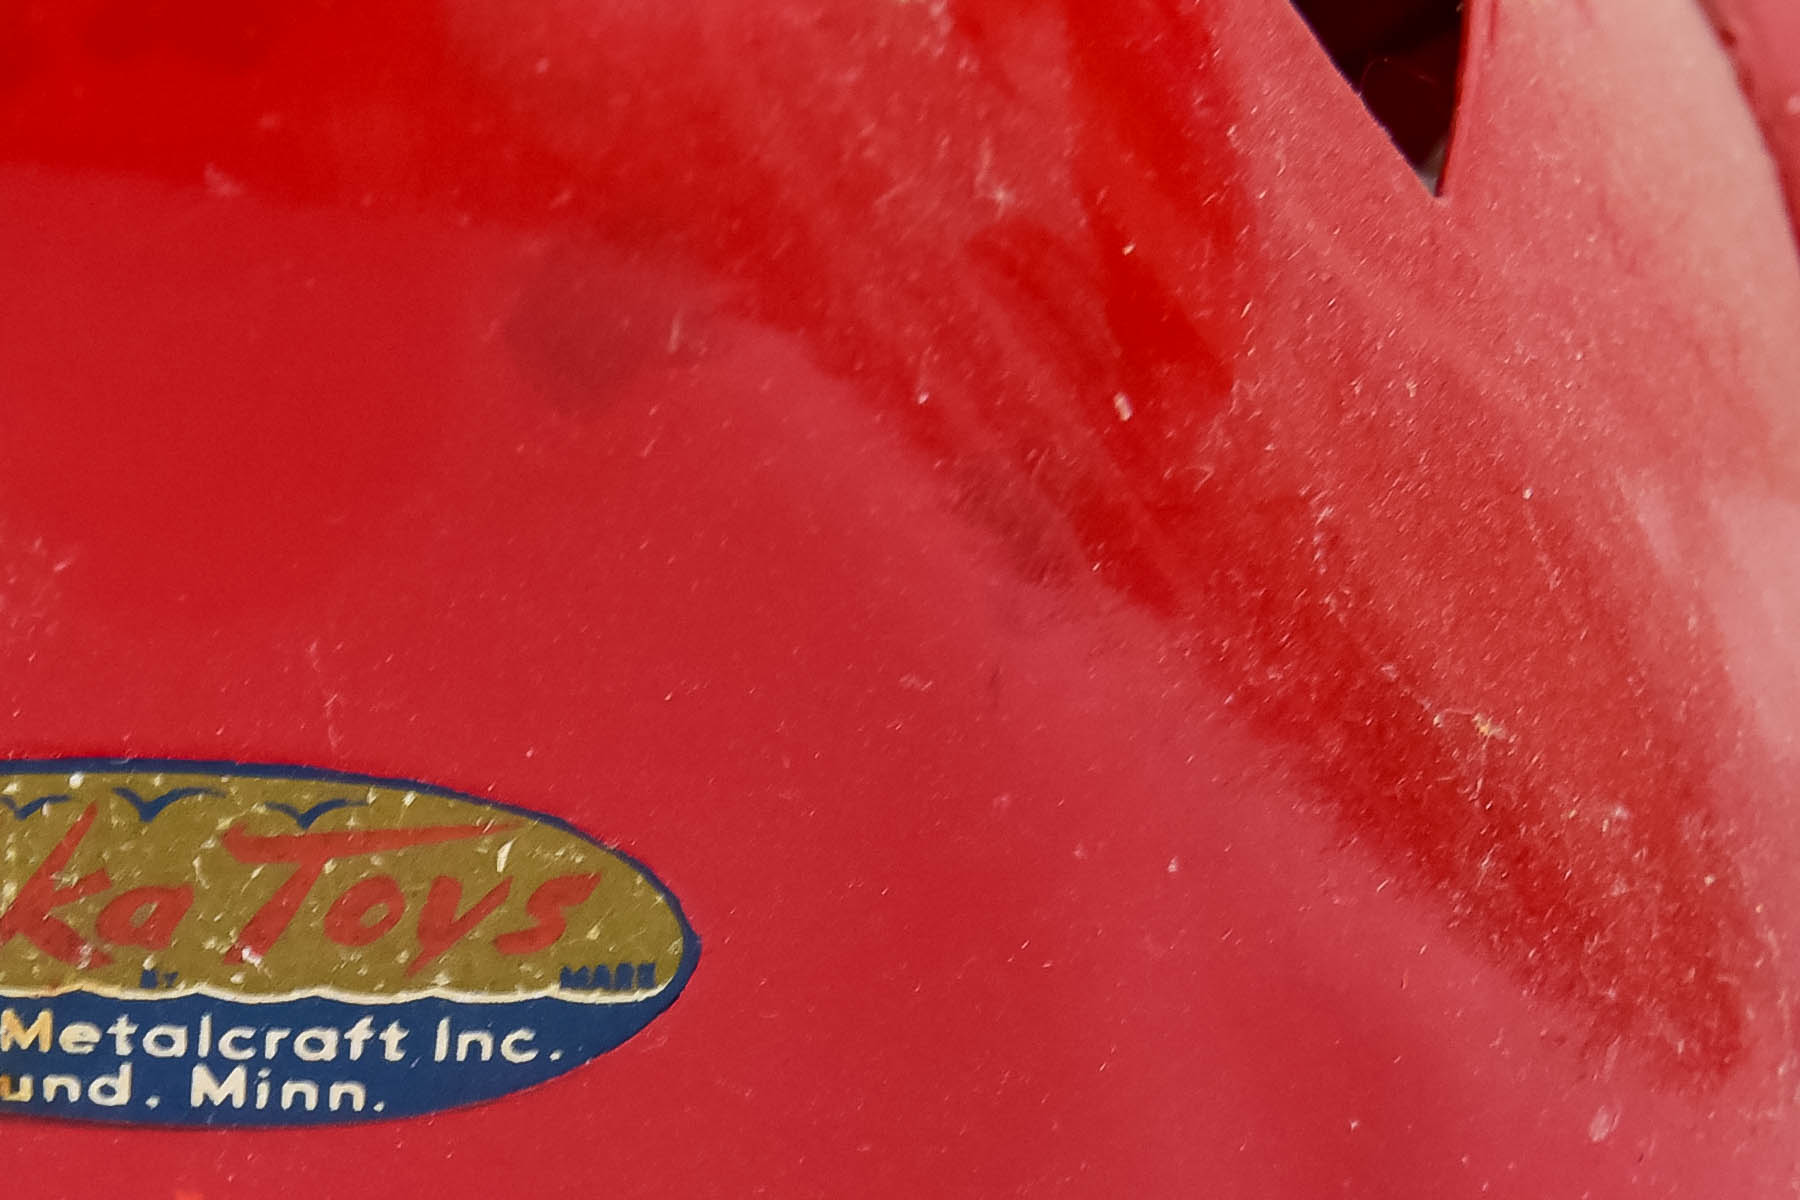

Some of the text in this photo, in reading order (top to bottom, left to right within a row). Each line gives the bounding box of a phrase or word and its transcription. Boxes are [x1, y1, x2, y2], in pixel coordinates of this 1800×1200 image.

[221, 822, 601, 977] Toys
[0, 1007, 409, 1062] Metalcraft
[434, 1018, 564, 1064] Inc.
[190, 1064, 385, 1113] Minn.
